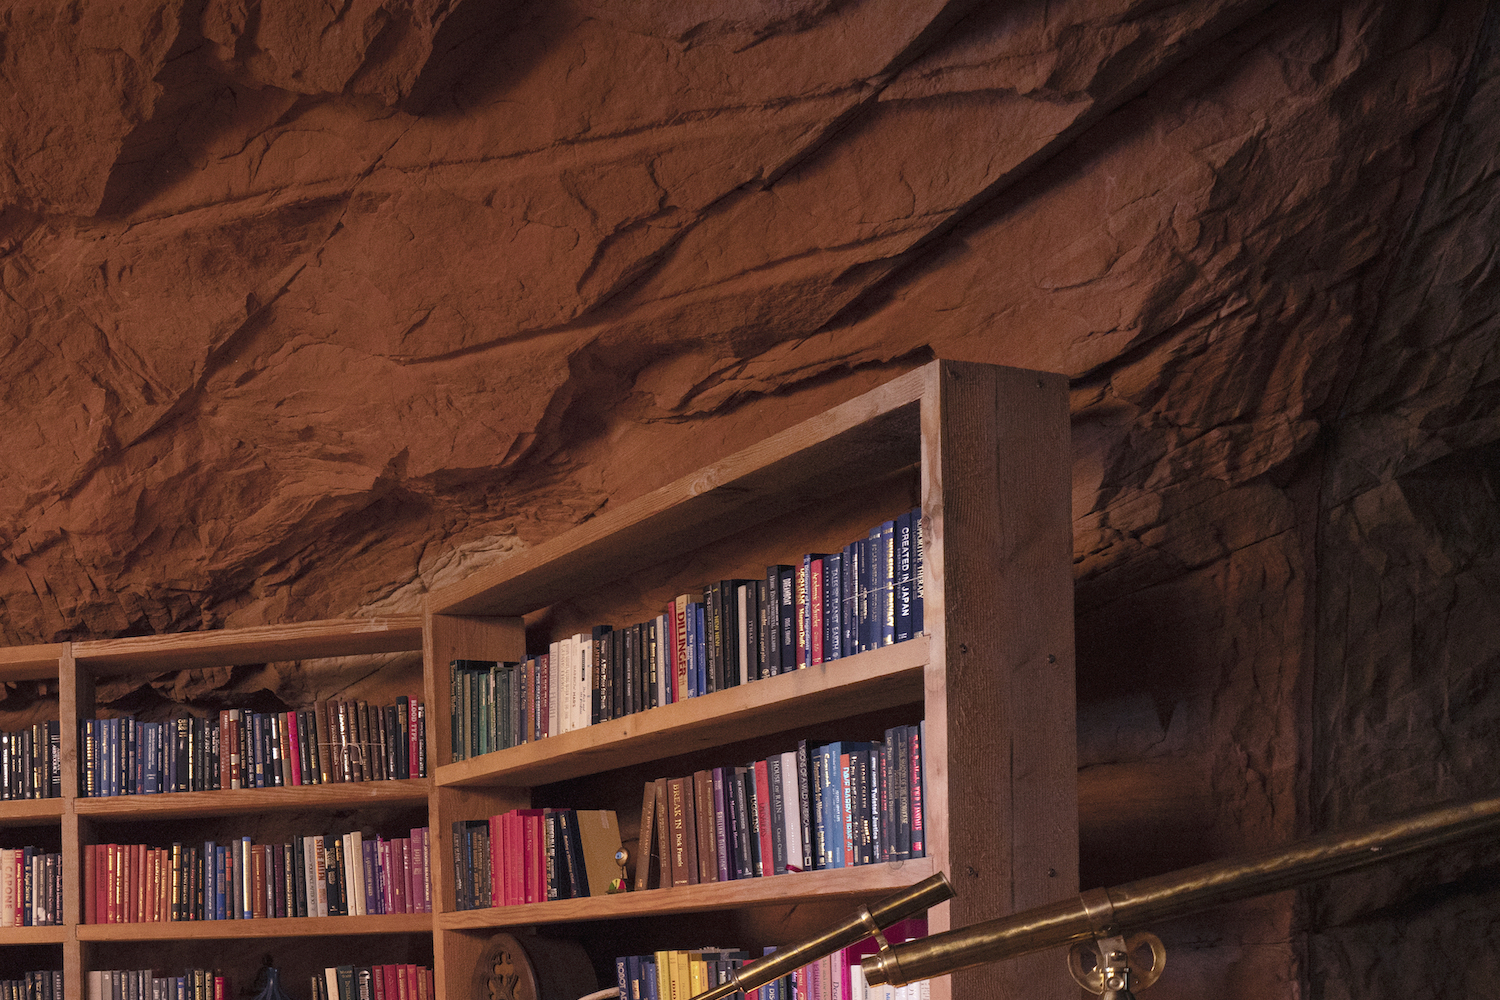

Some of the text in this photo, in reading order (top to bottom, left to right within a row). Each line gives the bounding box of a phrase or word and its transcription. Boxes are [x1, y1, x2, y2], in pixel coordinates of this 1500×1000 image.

[902, 574, 909, 584] IN
[901, 587, 909, 616] JAPAN
[677, 612, 686, 676] DILLINGER
[675, 820, 682, 830] IN
[5, 866, 13, 909] CAPONE
[617, 963, 626, 989] ROBOT
